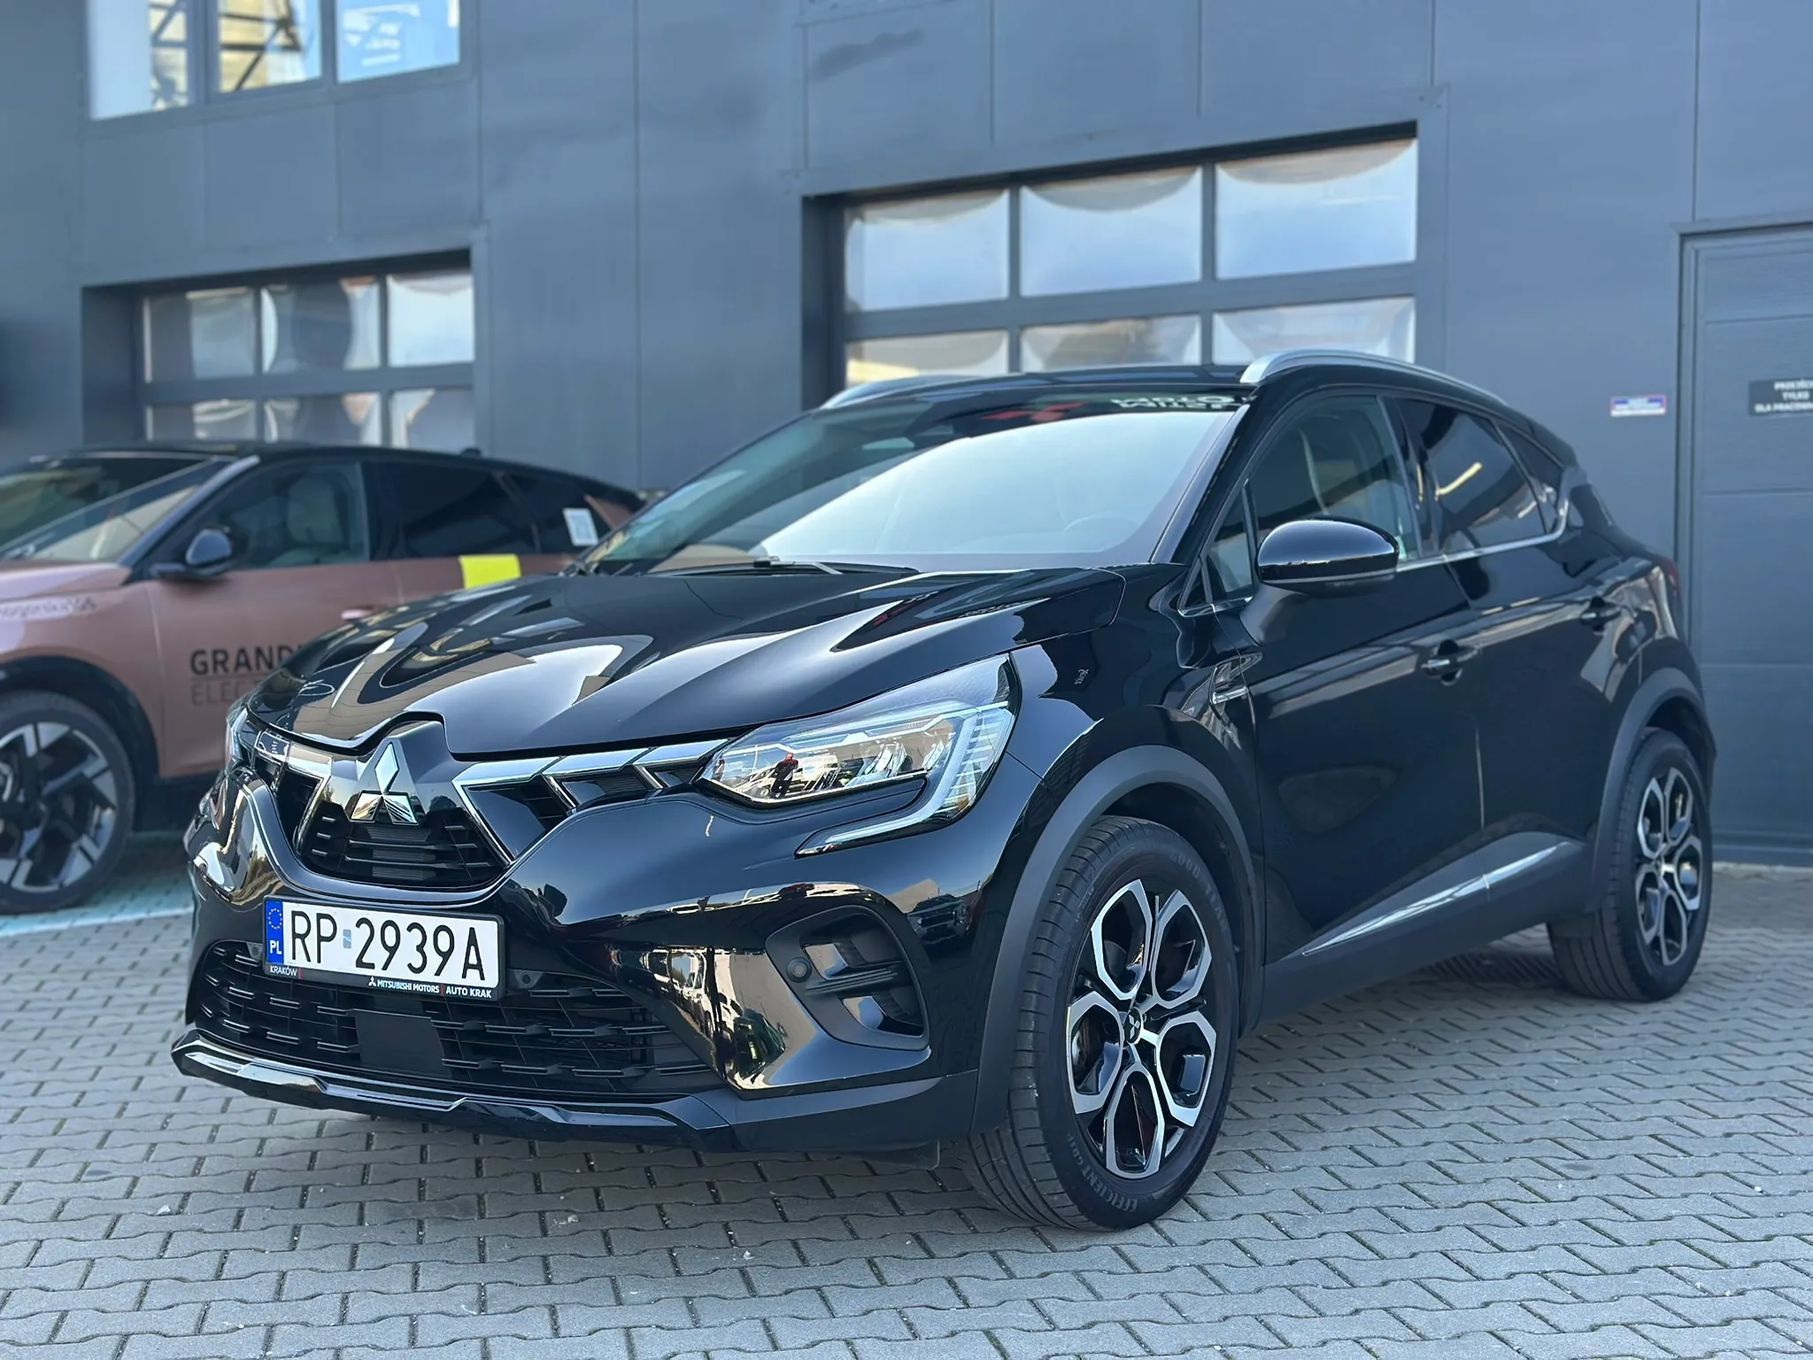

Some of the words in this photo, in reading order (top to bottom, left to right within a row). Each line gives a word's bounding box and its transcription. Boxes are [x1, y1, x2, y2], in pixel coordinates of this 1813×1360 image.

[190, 645, 300, 675] GRAND
[269, 939, 283, 956] PL
[290, 910, 338, 964] RP
[355, 917, 486, 981] 2939A
[270, 965, 297, 977] KRAKÓW
[377, 980, 412, 991] MITSUBISHI
[412, 983, 439, 994] MOTORS
[446, 987, 468, 996] AUTO
[469, 988, 492, 998] KRAK
